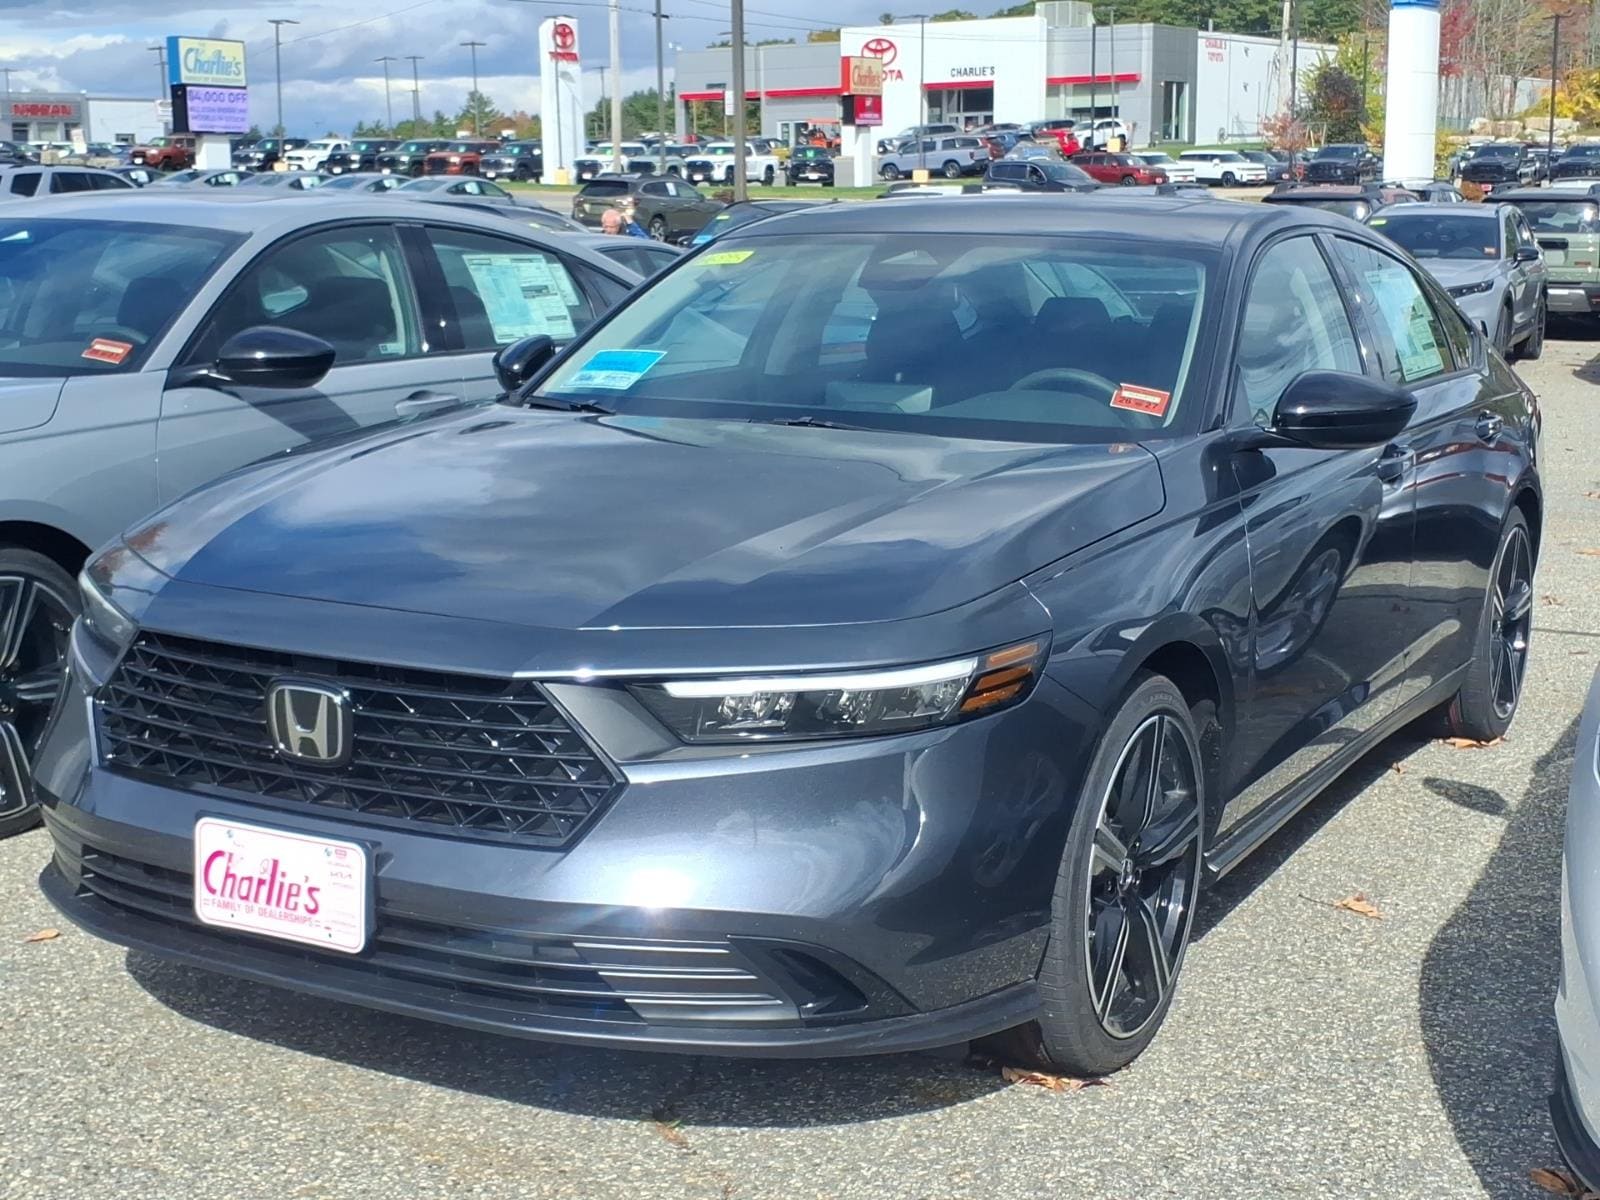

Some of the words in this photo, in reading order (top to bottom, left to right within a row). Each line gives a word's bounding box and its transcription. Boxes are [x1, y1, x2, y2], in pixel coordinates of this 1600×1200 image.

[184, 47, 242, 77] Charlie's
[882, 70, 903, 81] OTA
[950, 66, 996, 77] CHARLIE'S
[228, 92, 248, 103] OFF
[13, 103, 73, 116] NISSAN
[203, 849, 320, 915] Charlie's
[211, 900, 243, 912] FAMILY
[245, 904, 256, 915] OF
[257, 907, 314, 926] DEALERSHIPS
